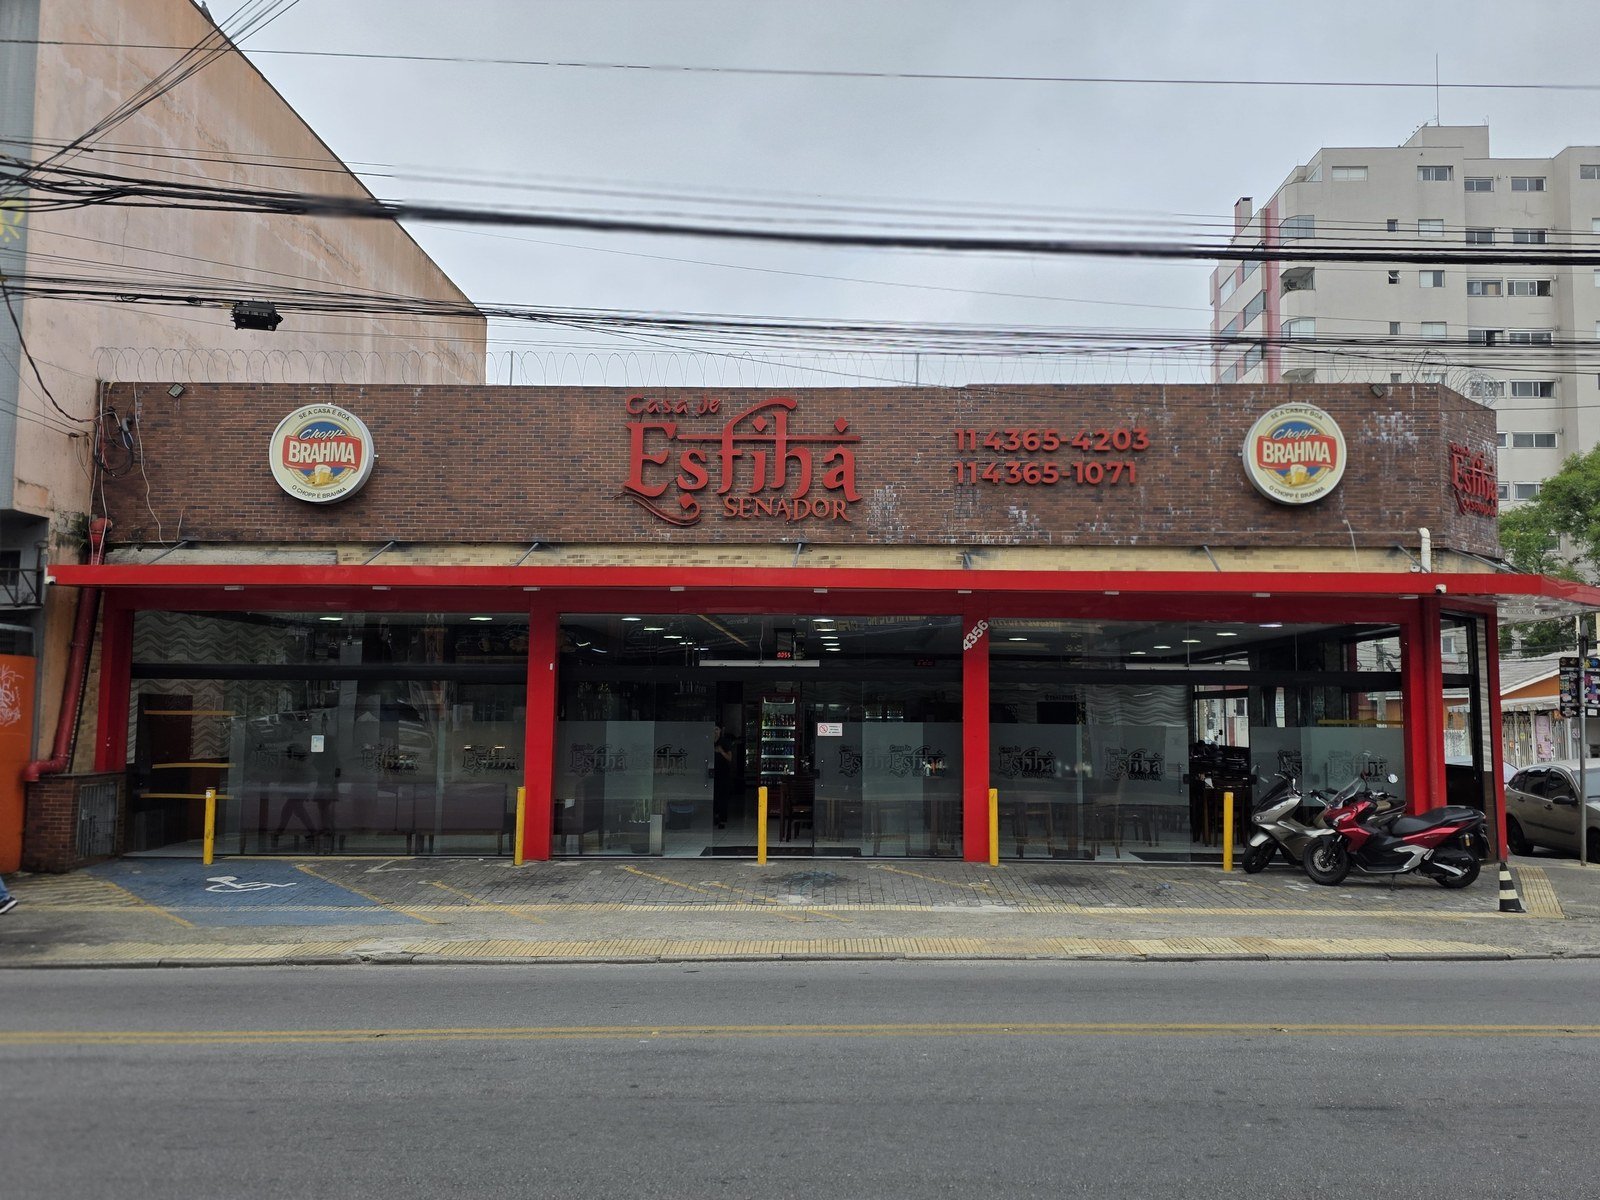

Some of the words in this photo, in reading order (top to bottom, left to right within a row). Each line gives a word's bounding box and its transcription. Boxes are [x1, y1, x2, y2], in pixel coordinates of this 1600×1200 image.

[337, 411, 350, 421] BOA
[626, 393, 688, 416] Casa
[696, 393, 720, 414] de
[300, 428, 346, 440] Chopp
[954, 428, 977, 451] 11
[983, 428, 1150, 451] 4365-4203
[1272, 428, 1320, 440] Chopp
[289, 440, 356, 464] BRAHMA
[1262, 441, 1331, 464] BRAHMA
[953, 461, 977, 484] 11
[981, 461, 1137, 484] 4365-1071
[296, 487, 316, 498] CHOPP
[322, 487, 347, 498] BRAHMA
[1301, 486, 1325, 498] BRAHMA
[722, 495, 853, 522] SENADOR
[963, 619, 989, 651] 4356
